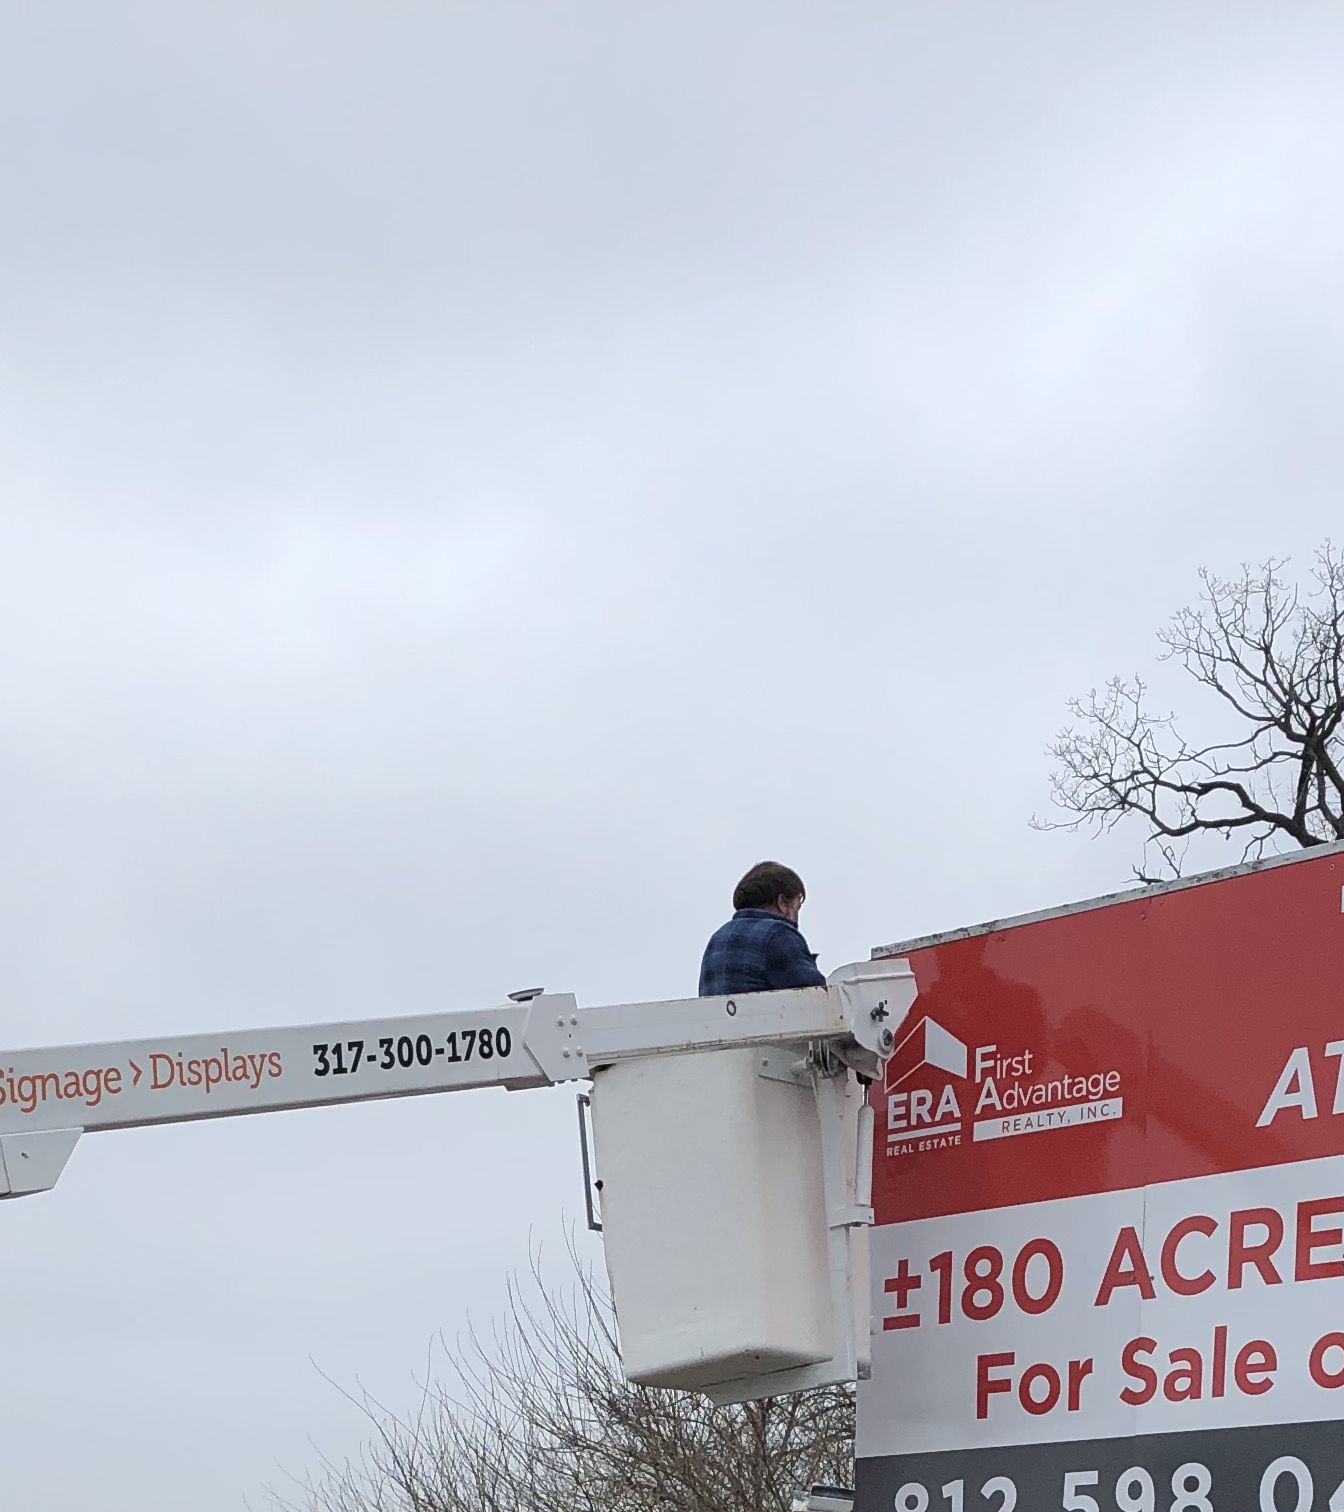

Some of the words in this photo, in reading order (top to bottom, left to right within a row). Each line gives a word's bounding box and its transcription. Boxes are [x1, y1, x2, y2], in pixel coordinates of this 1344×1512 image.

[149, 1049, 283, 1099] Displays
[312, 1026, 512, 1077] 317-300-1780
[975, 1044, 1033, 1083] First
[888, 1084, 961, 1130] ERA
[974, 1070, 1121, 1115] Advantage
[1001, 1111, 1071, 1133] REALTY,
[1080, 1103, 1117, 1121] INC.
[886, 1144, 915, 1157] REAL
[918, 1135, 961, 1151] ESTATE
[882, 1238, 1064, 1331] ±180
[976, 1352, 1094, 1420] For
[1119, 1326, 1278, 1406] Sale
